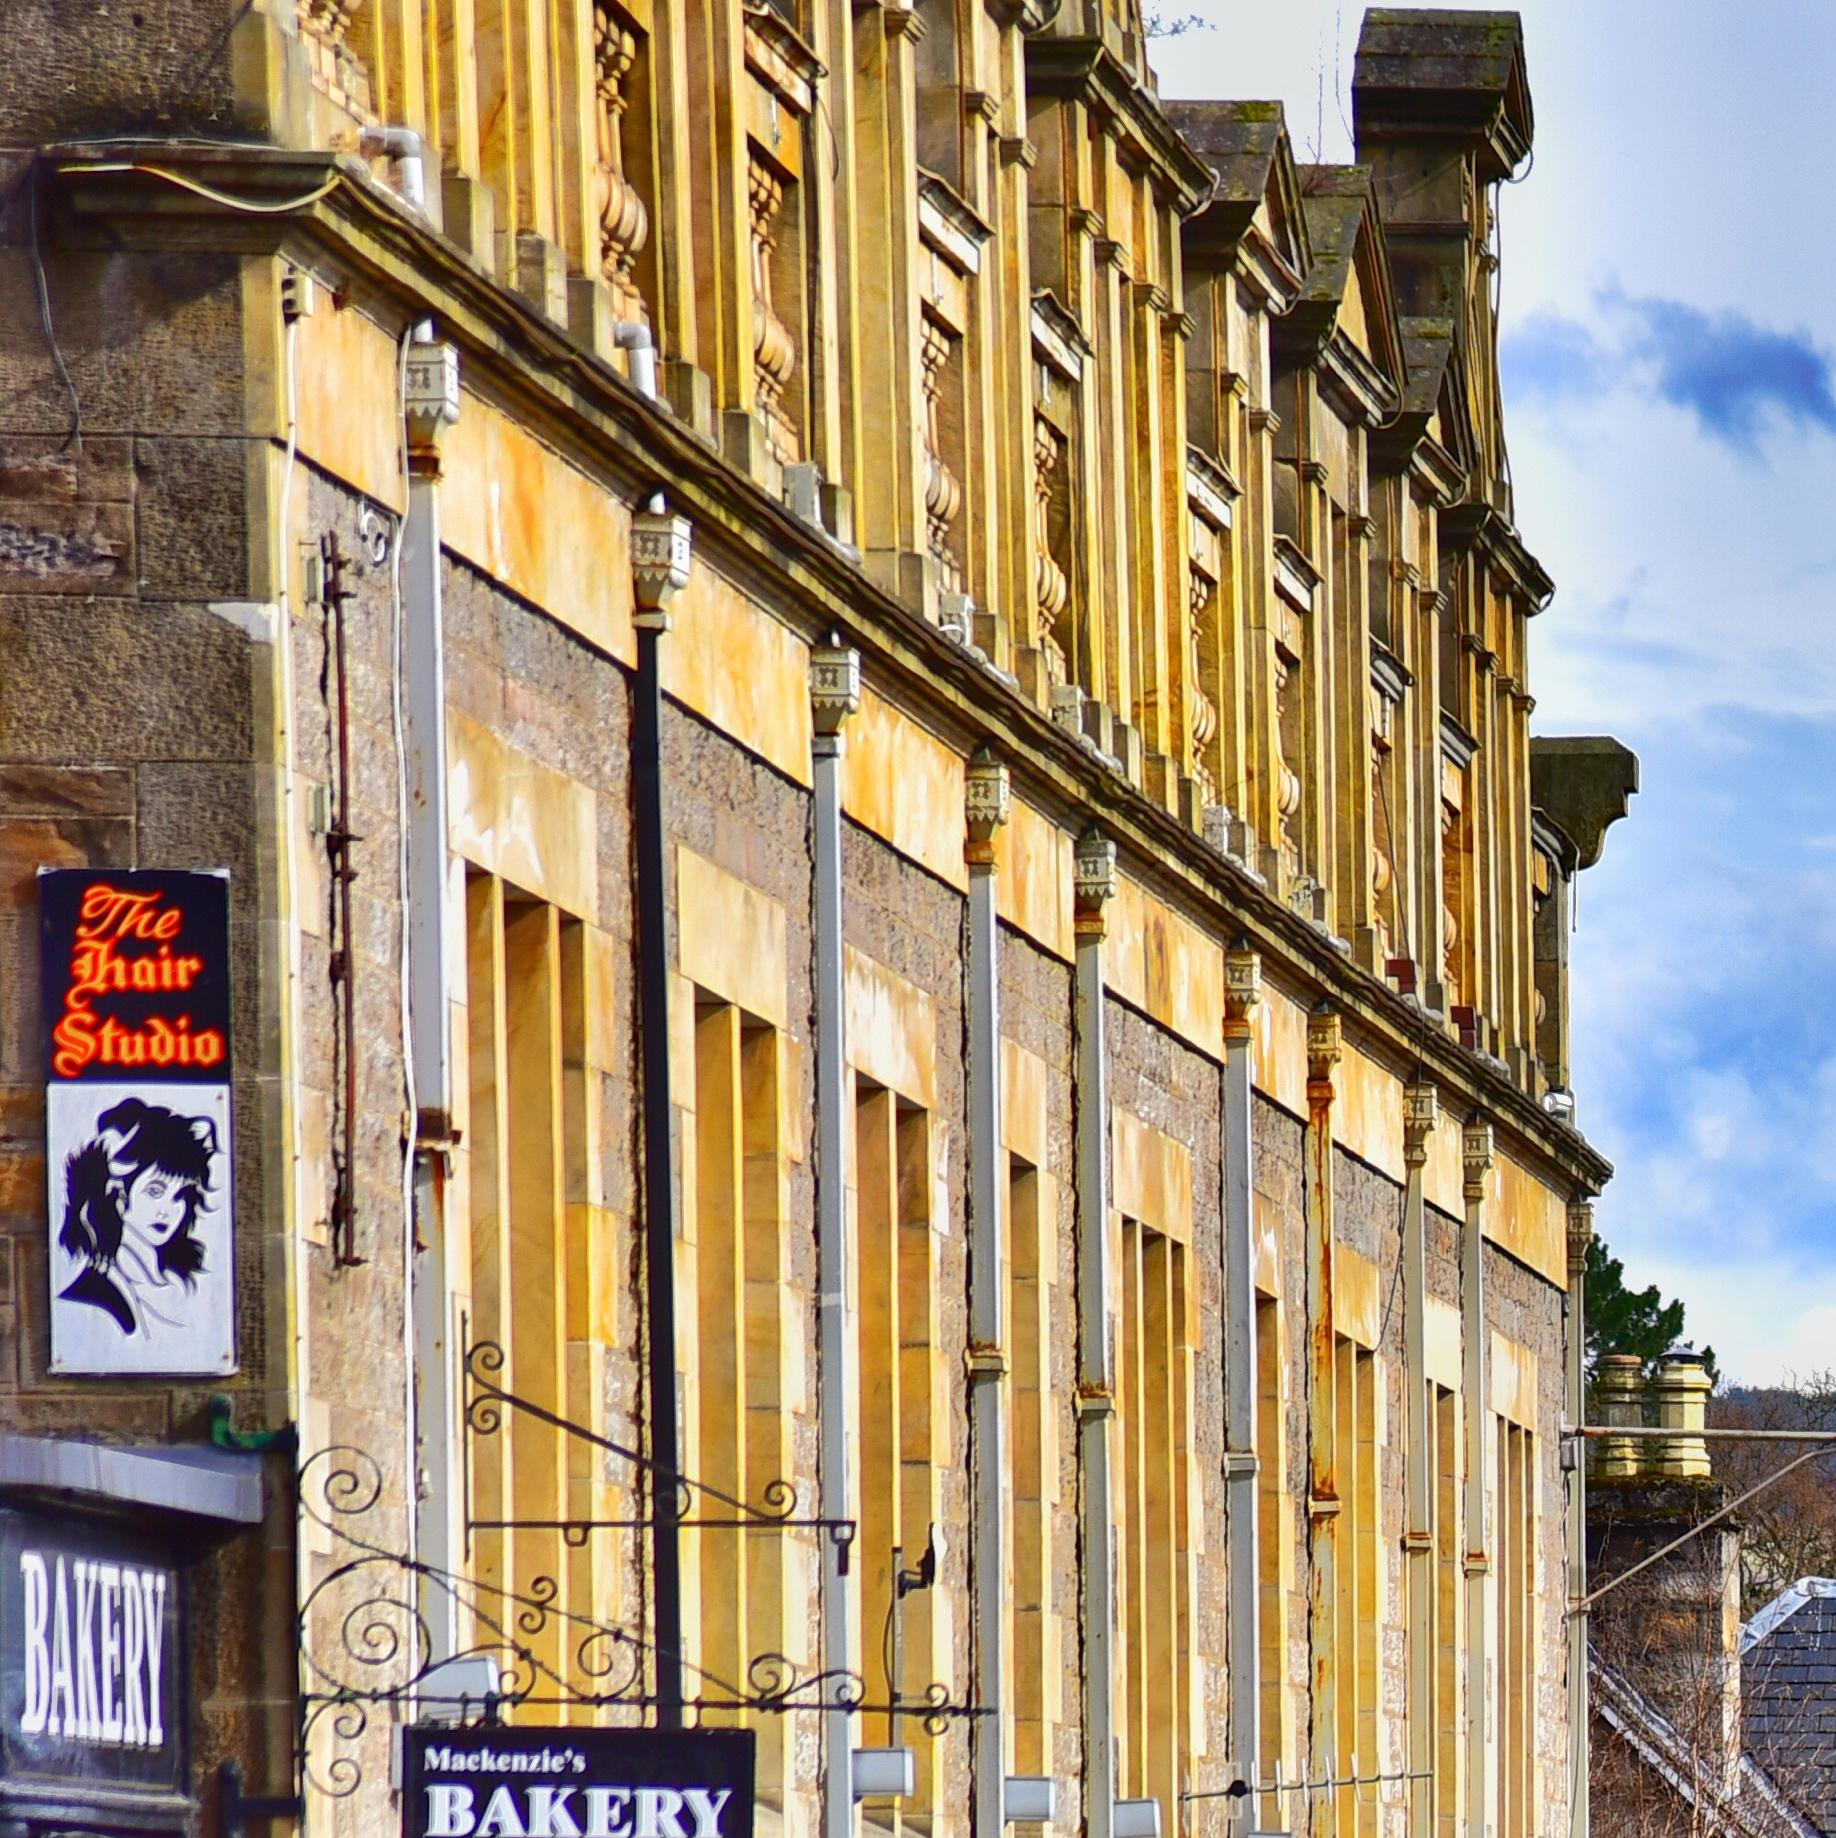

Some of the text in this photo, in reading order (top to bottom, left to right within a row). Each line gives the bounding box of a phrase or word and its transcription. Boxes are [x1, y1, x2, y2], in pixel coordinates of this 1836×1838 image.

[75, 883, 182, 940] The
[53, 1011, 225, 1078] Studio
[20, 1550, 166, 1746] BAKERY
[423, 1746, 587, 1774] Mackenzie's
